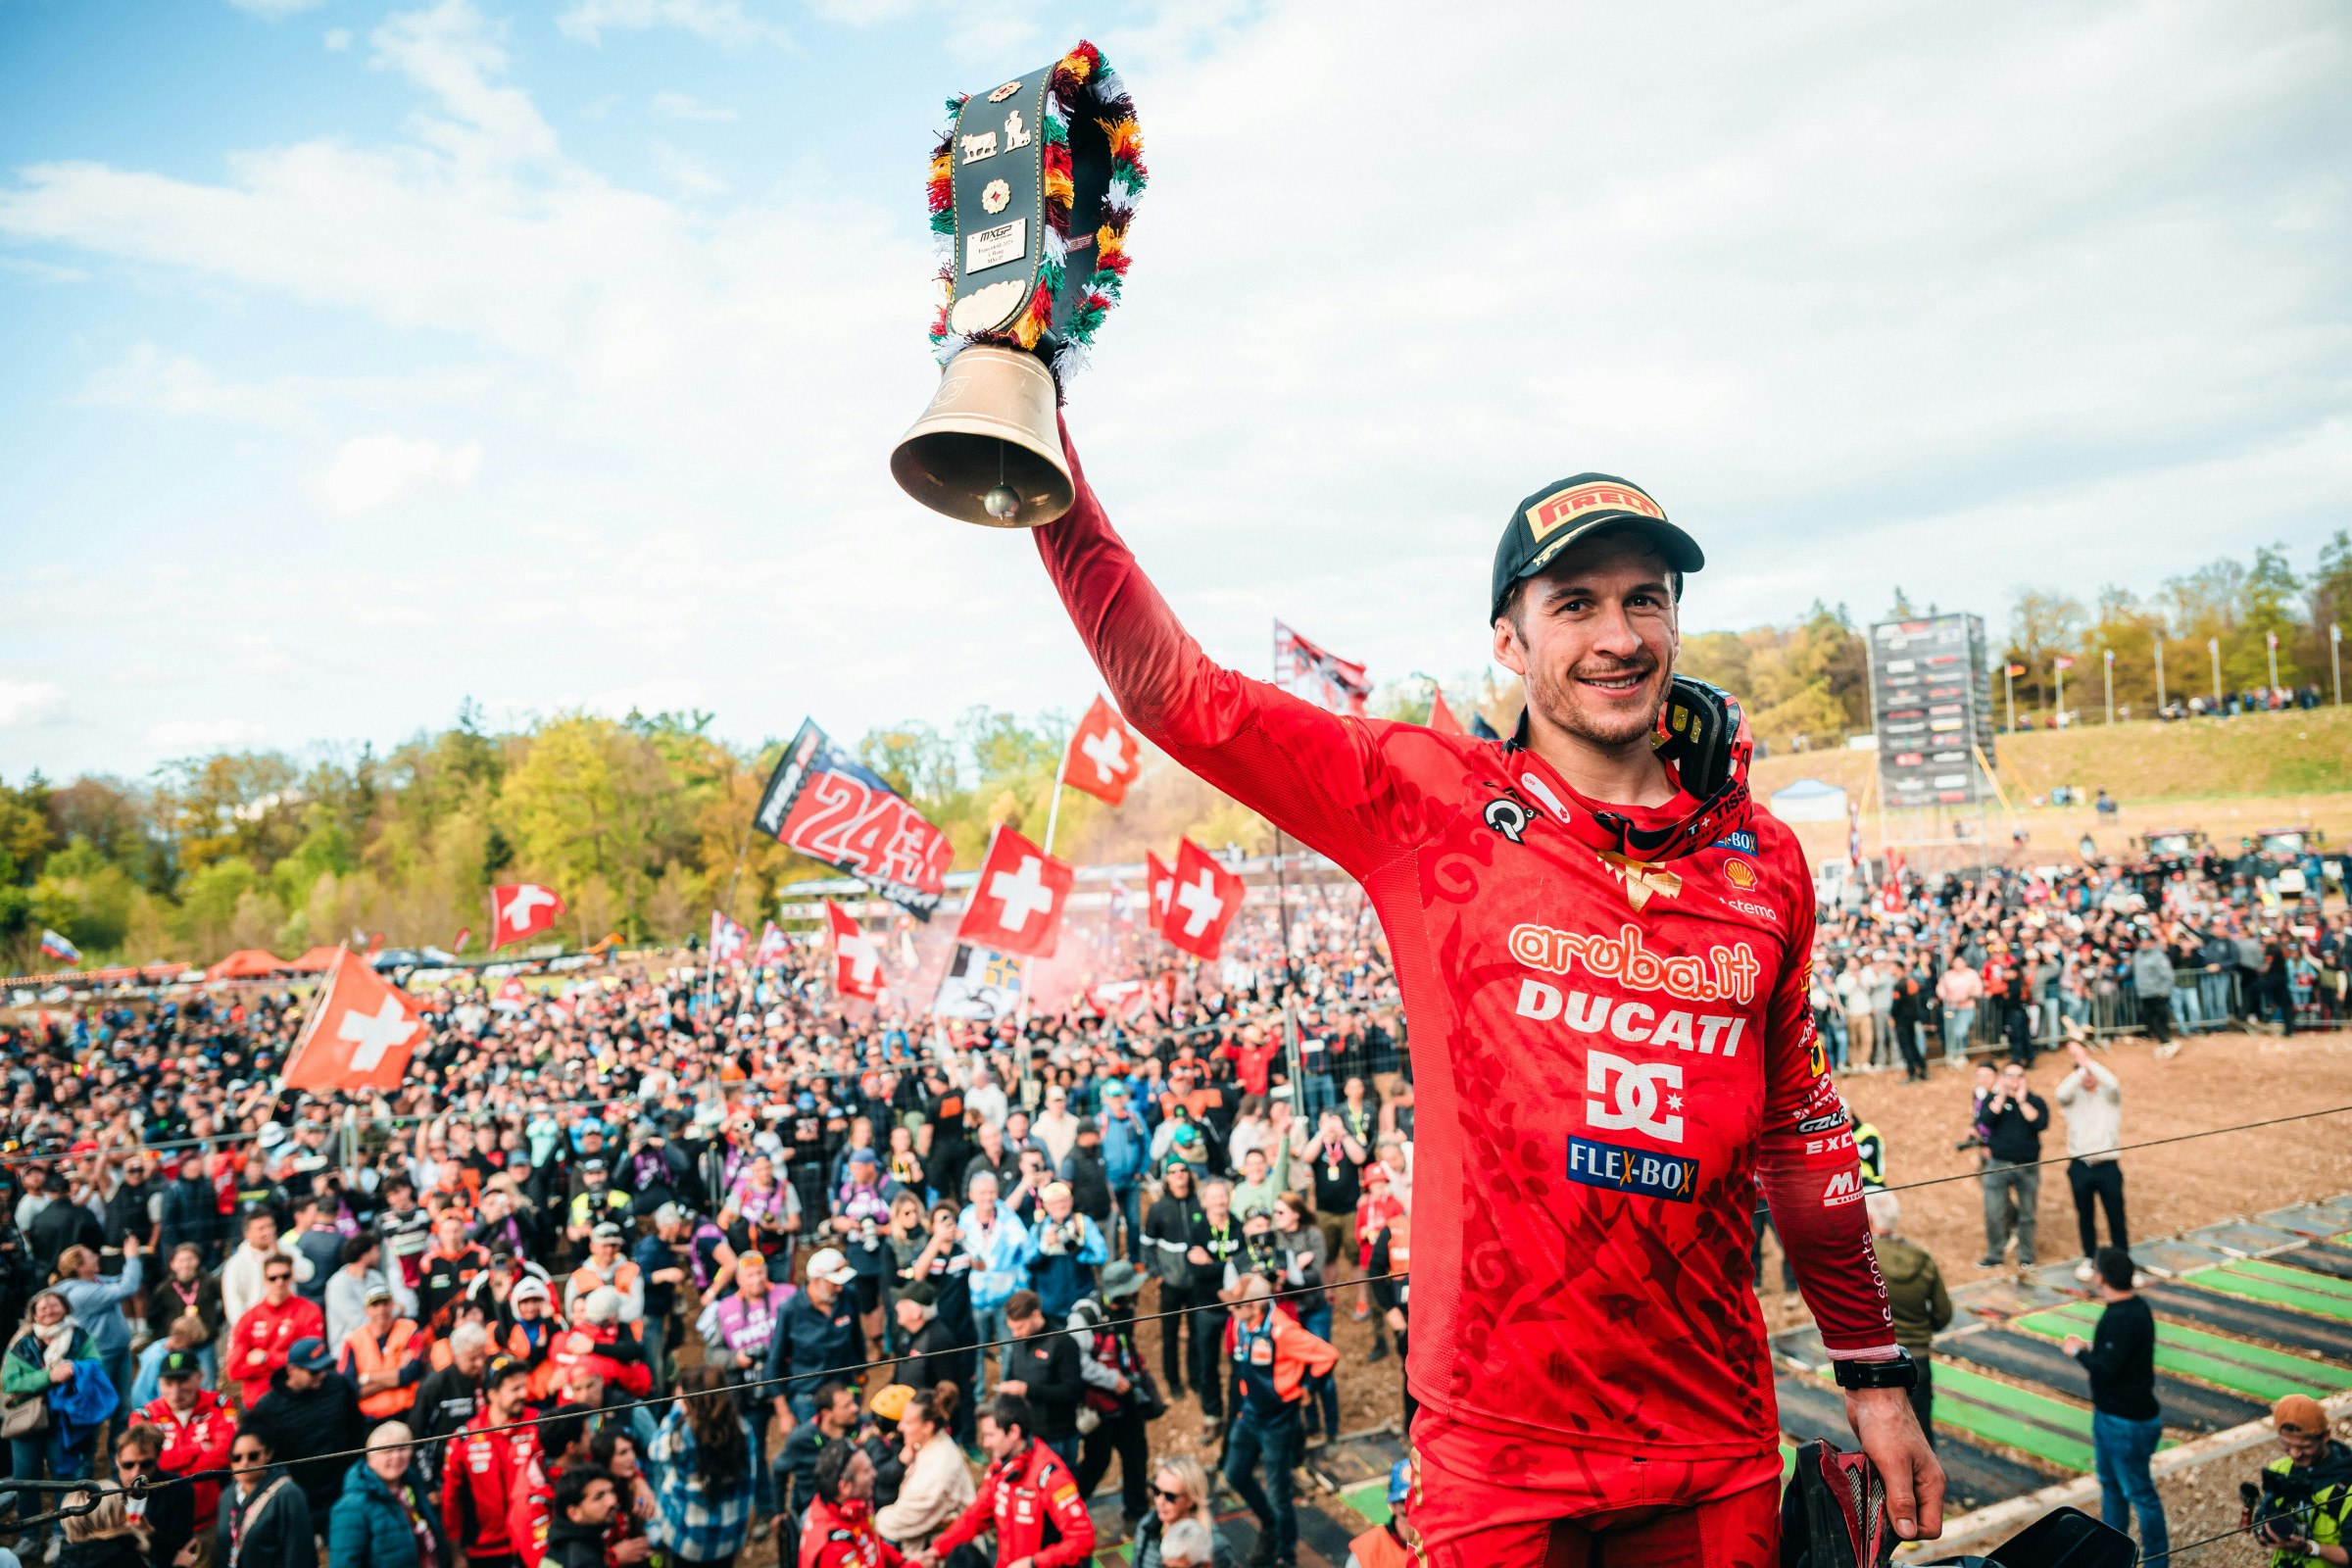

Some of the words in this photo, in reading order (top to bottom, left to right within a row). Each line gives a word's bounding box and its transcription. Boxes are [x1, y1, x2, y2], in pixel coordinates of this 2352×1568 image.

[980, 224, 1012, 242] MXGP
[1687, 831, 1710, 847] SWISS
[1713, 810, 1742, 831] WATCHES
[1508, 923, 1761, 1005] aruba.it
[1515, 978, 1747, 1057] DUCATI
[1587, 1049, 1685, 1144] DC
[1570, 1143, 1695, 1198] FLEX-BOX
